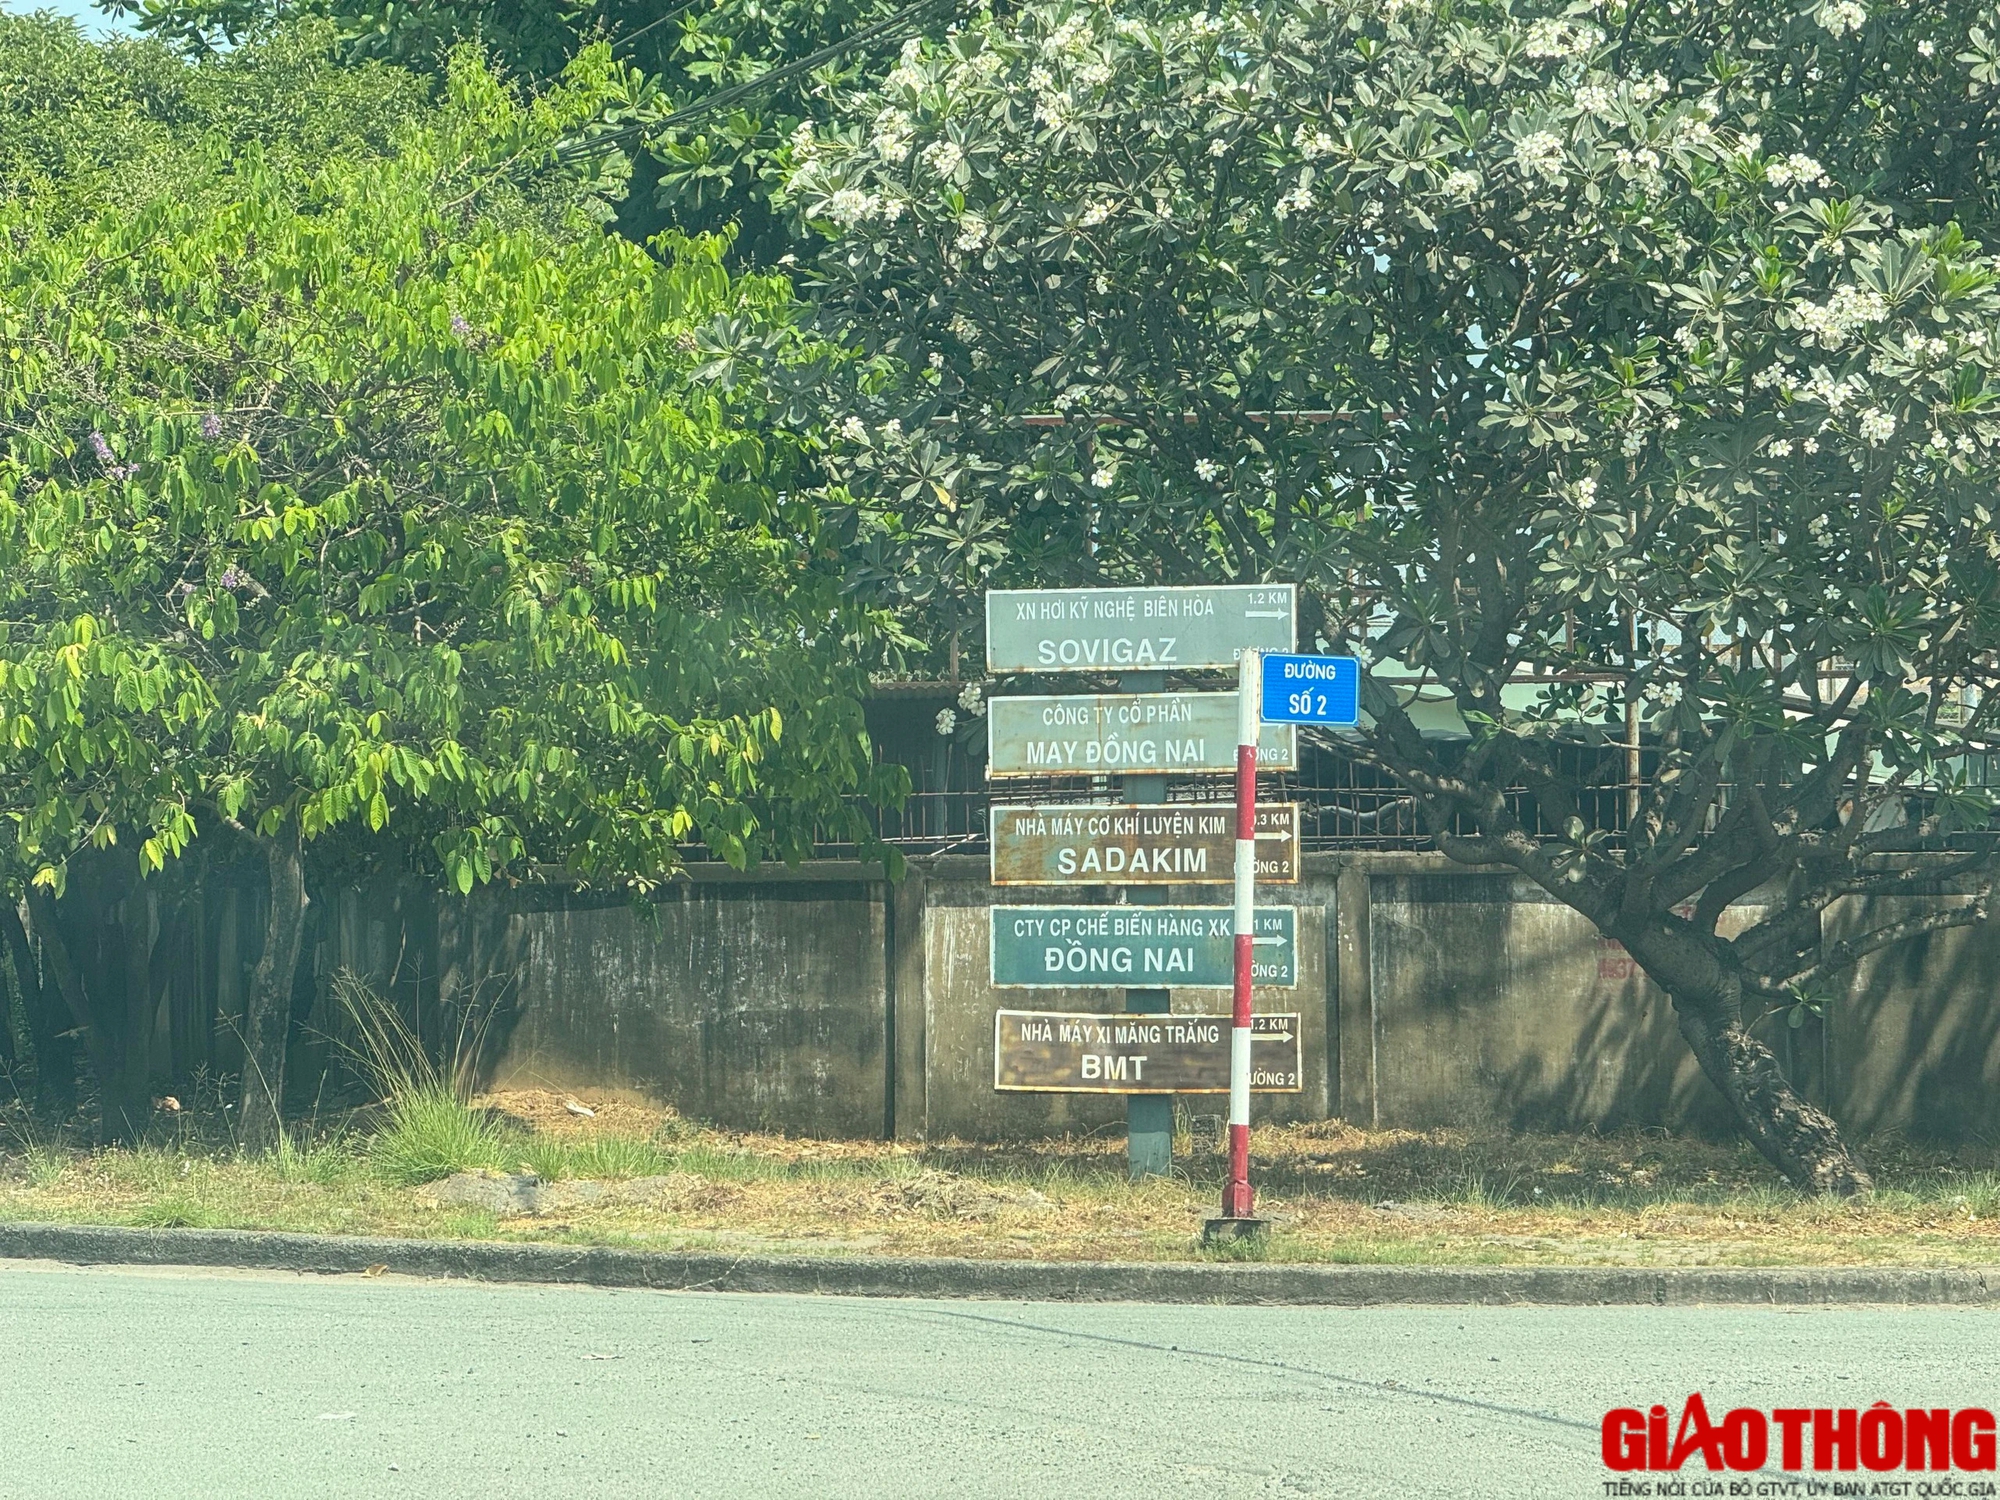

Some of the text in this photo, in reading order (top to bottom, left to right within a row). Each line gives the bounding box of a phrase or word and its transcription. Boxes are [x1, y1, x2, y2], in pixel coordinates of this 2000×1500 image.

[1016, 603, 1036, 620] XN
[1070, 596, 1089, 619] KỸ
[1094, 596, 1135, 621] NGHỆ
[1144, 595, 1178, 617] BIÊN
[1183, 594, 1214, 616] HÒA
[1248, 592, 1287, 604] 1.2 KM
[1038, 637, 1177, 664] SOVIGAZ
[1284, 660, 1336, 681] ĐƯỜNG
[1042, 698, 1192, 725] CÔNG TY CỔ PHẦN
[1289, 686, 1327, 716] SỐ 2
[1027, 732, 1204, 764] MAY ĐỒNG NAI
[1281, 748, 1288, 760] 2
[1015, 813, 1046, 836] NHÀ
[1051, 813, 1083, 835] MÁY
[1088, 815, 1110, 835] CƠ
[1114, 812, 1139, 835] KHÍ
[1199, 817, 1225, 834] KIM
[1271, 813, 1290, 825] KM
[1057, 847, 1206, 874] SADAKIM
[1282, 860, 1289, 873] 2
[1014, 911, 1230, 937] CTY CP CHẾ BIẾN HÀNG XK
[1263, 919, 1282, 931] KM
[1045, 938, 1193, 972] ĐỒNG NAI
[1280, 965, 1288, 978] 2
[1021, 1019, 1219, 1044] NHÀ MÁY XI MĂNG TRẮNG
[1250, 1018, 1288, 1030] 1.2 KM
[1082, 1054, 1147, 1080] BMT
[1250, 1067, 1295, 1085] ƯỜNG 2
